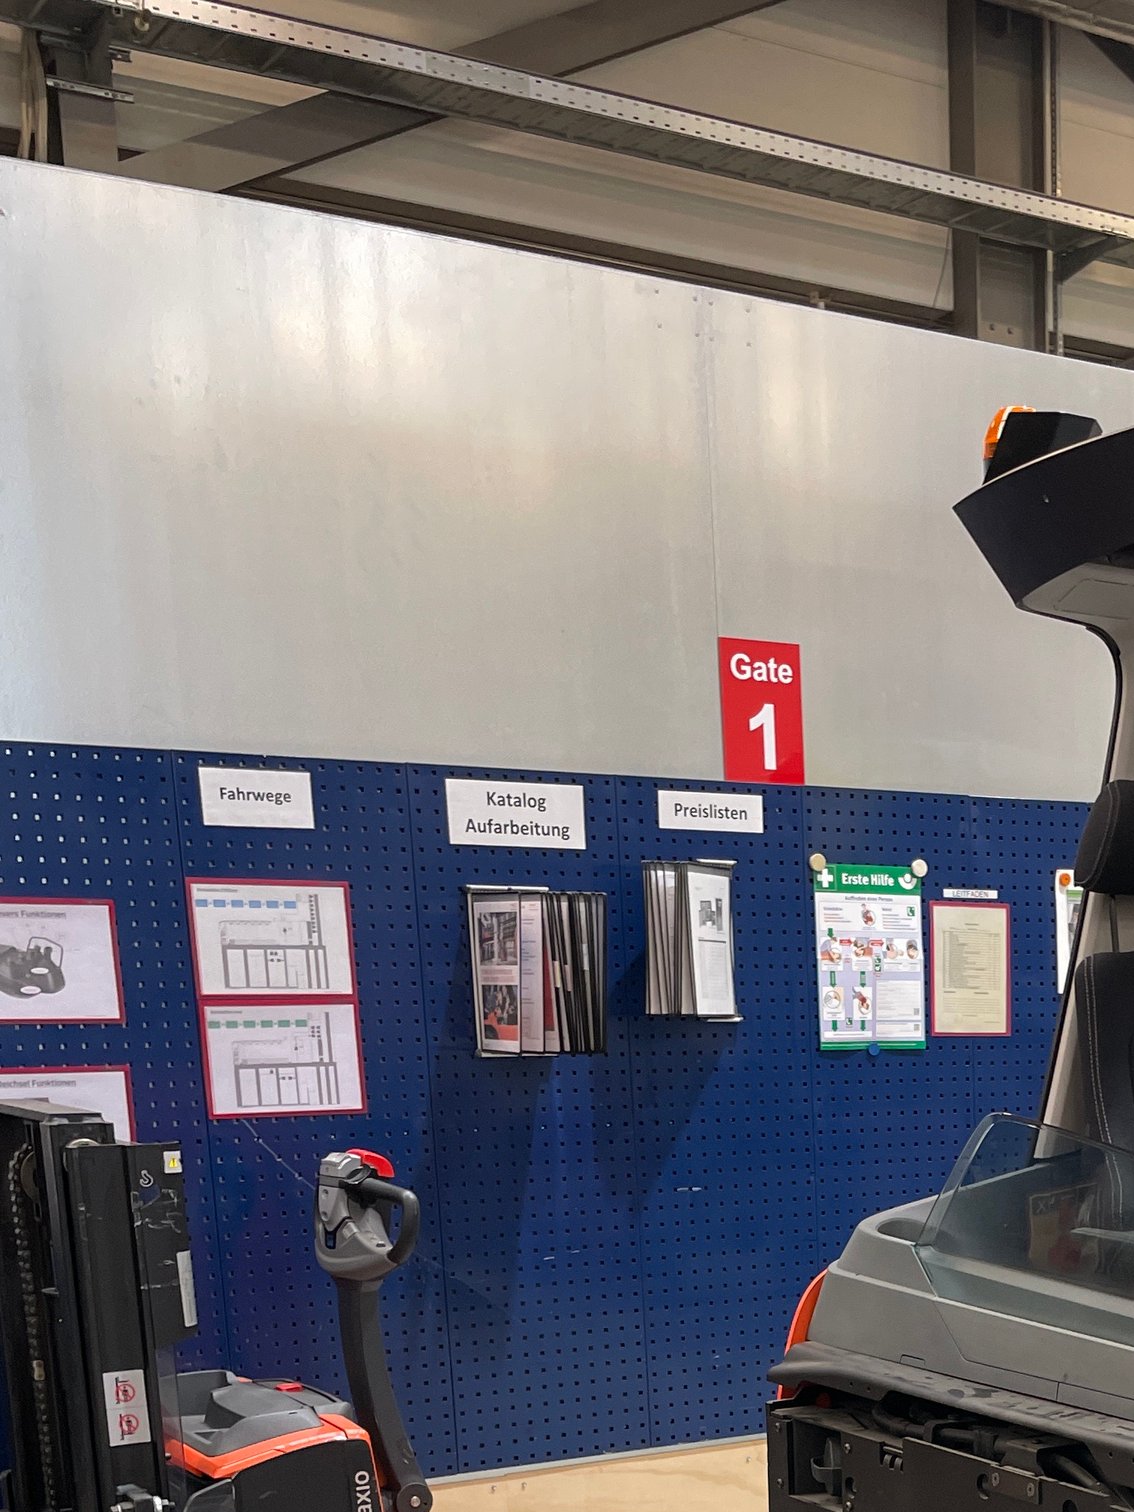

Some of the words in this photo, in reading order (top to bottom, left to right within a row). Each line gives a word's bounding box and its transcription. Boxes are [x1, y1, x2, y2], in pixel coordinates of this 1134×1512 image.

[730, 652, 794, 684] Gate
[748, 703, 777, 771] 1
[219, 787, 292, 806] Fahrwege
[486, 791, 547, 812] Katalog
[674, 803, 748, 820] Preislisten
[465, 818, 570, 841] Aufarbeitung
[841, 873, 869, 885] Erste
[870, 874, 895, 886] Hilfe
[952, 890, 989, 898] LEITFADEN
[0, 1080, 30, 1088] eichsel
[32, 1079, 76, 1088] Funktionen
